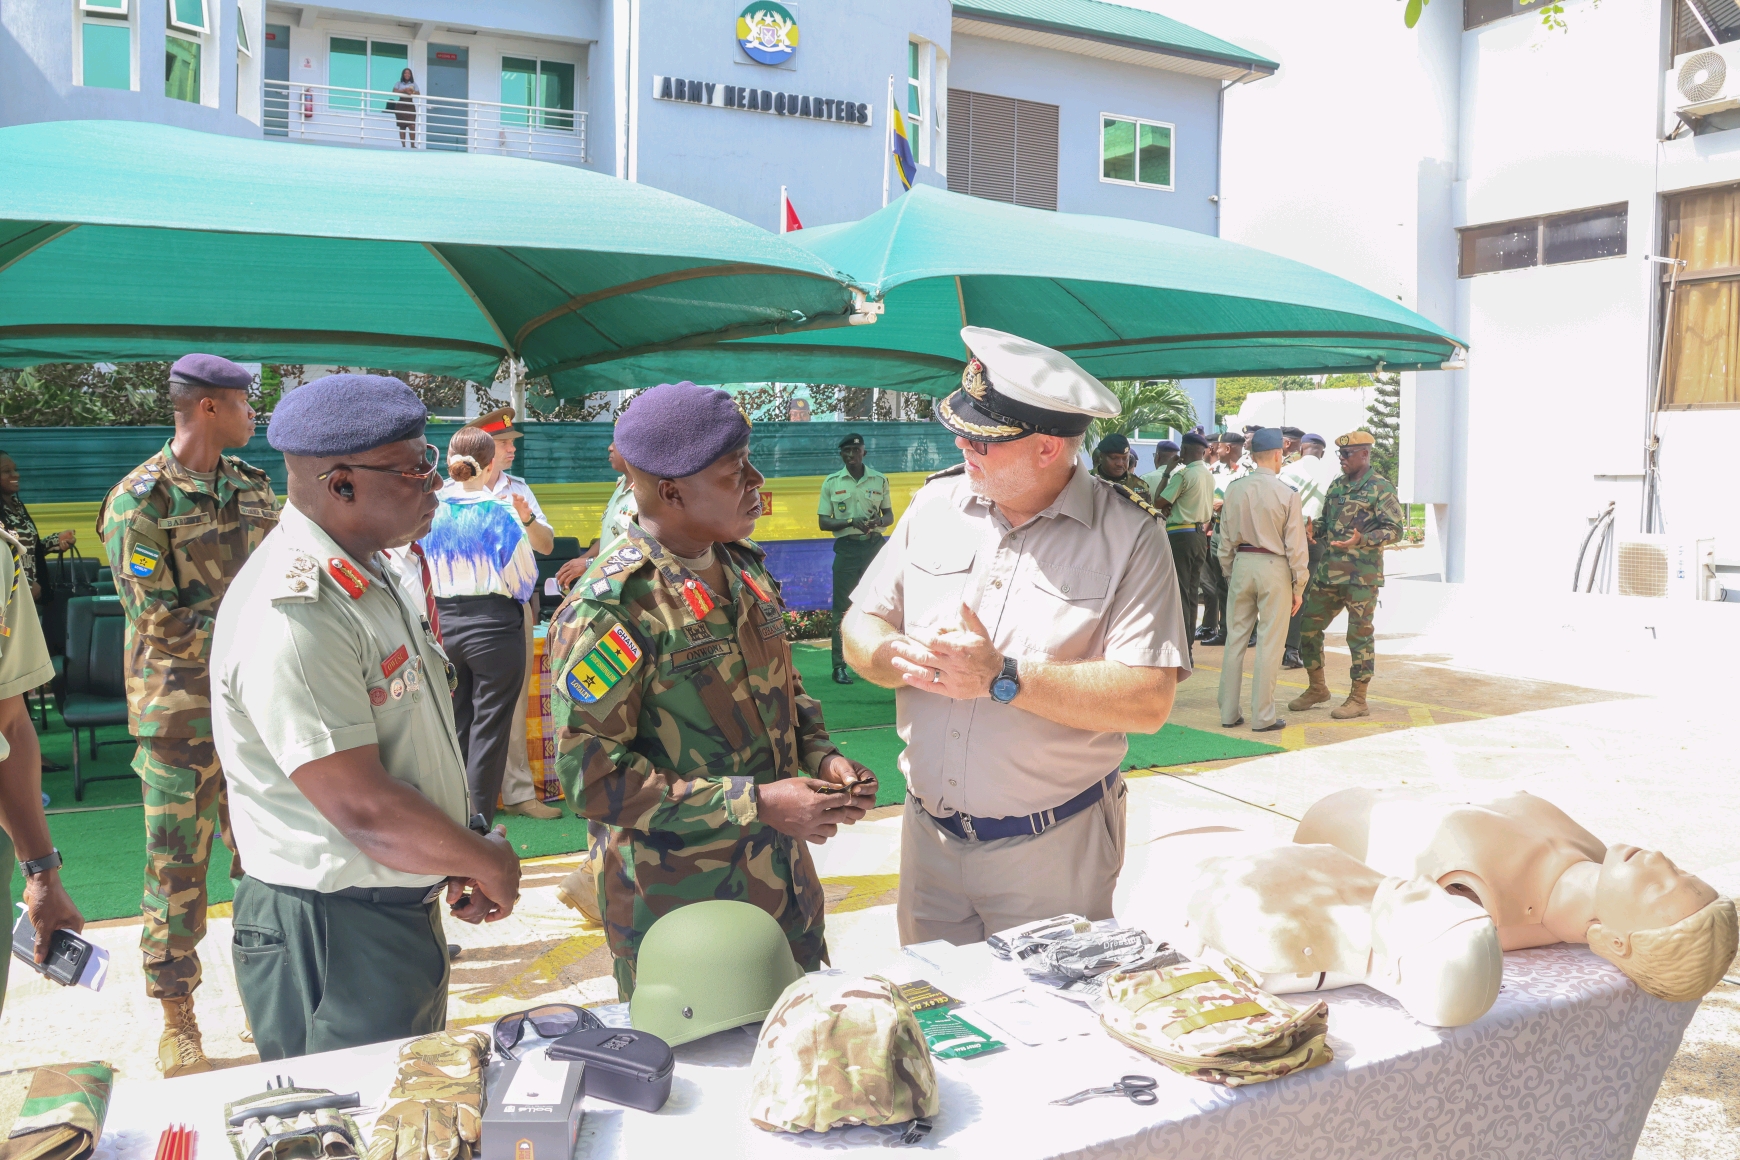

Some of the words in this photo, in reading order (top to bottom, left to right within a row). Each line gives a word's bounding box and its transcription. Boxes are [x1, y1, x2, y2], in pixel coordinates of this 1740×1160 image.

[661, 76, 716, 105] ARMY
[723, 84, 868, 124] HEADQUARTERS
[616, 628, 638, 655] GHANA
[686, 643, 724, 661] ONWONA
[570, 679, 591, 700] LOYALTY
